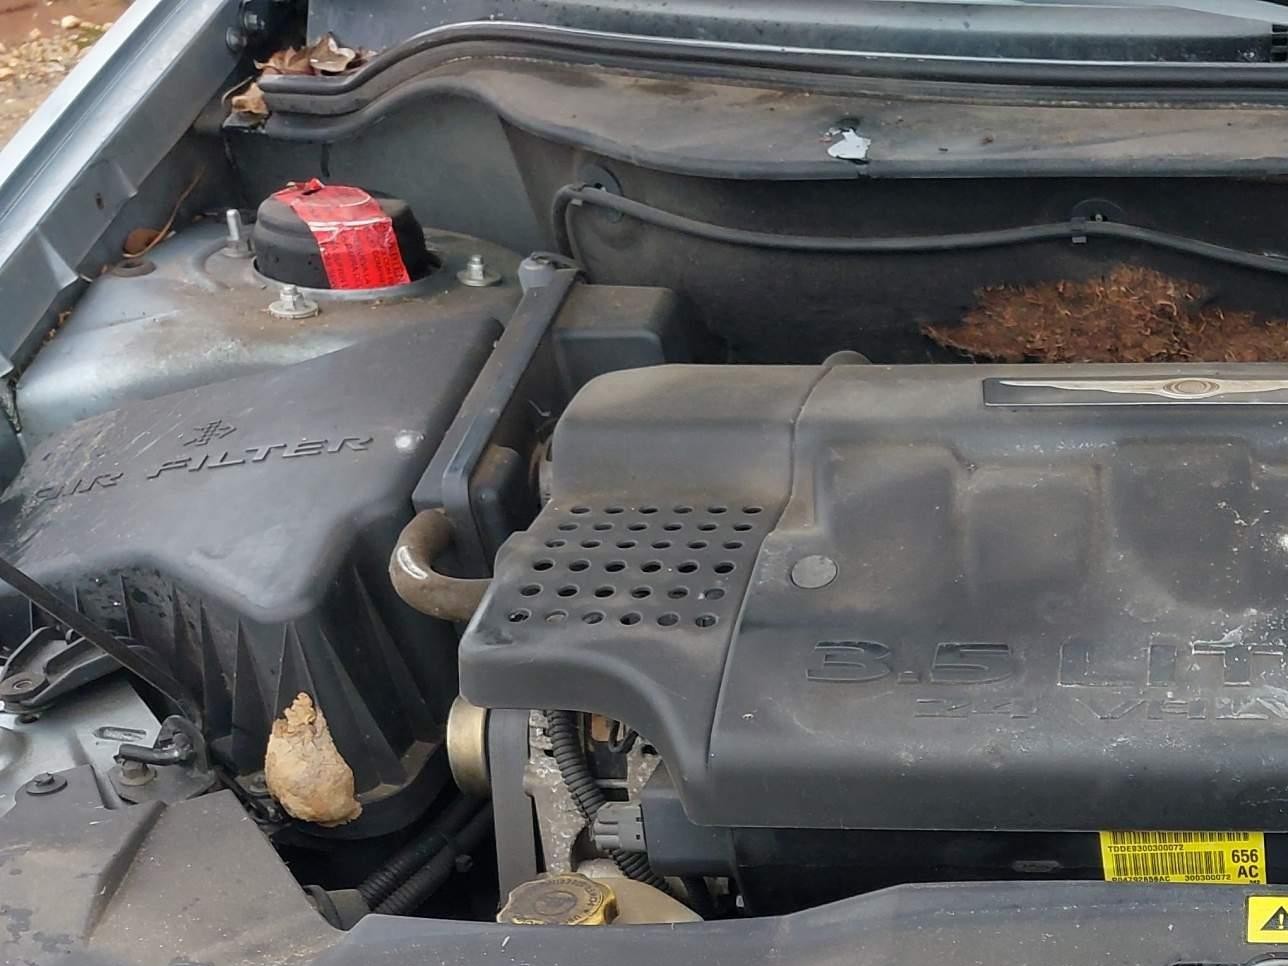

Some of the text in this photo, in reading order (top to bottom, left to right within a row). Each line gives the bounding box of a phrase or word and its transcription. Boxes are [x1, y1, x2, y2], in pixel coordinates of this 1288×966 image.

[35, 436, 374, 502] AIR FILTER
[806, 639, 1016, 685] 3.5
[1231, 849, 1259, 864] 656
[1184, 874, 1231, 882] 300300072
[1237, 865, 1259, 879] AC
